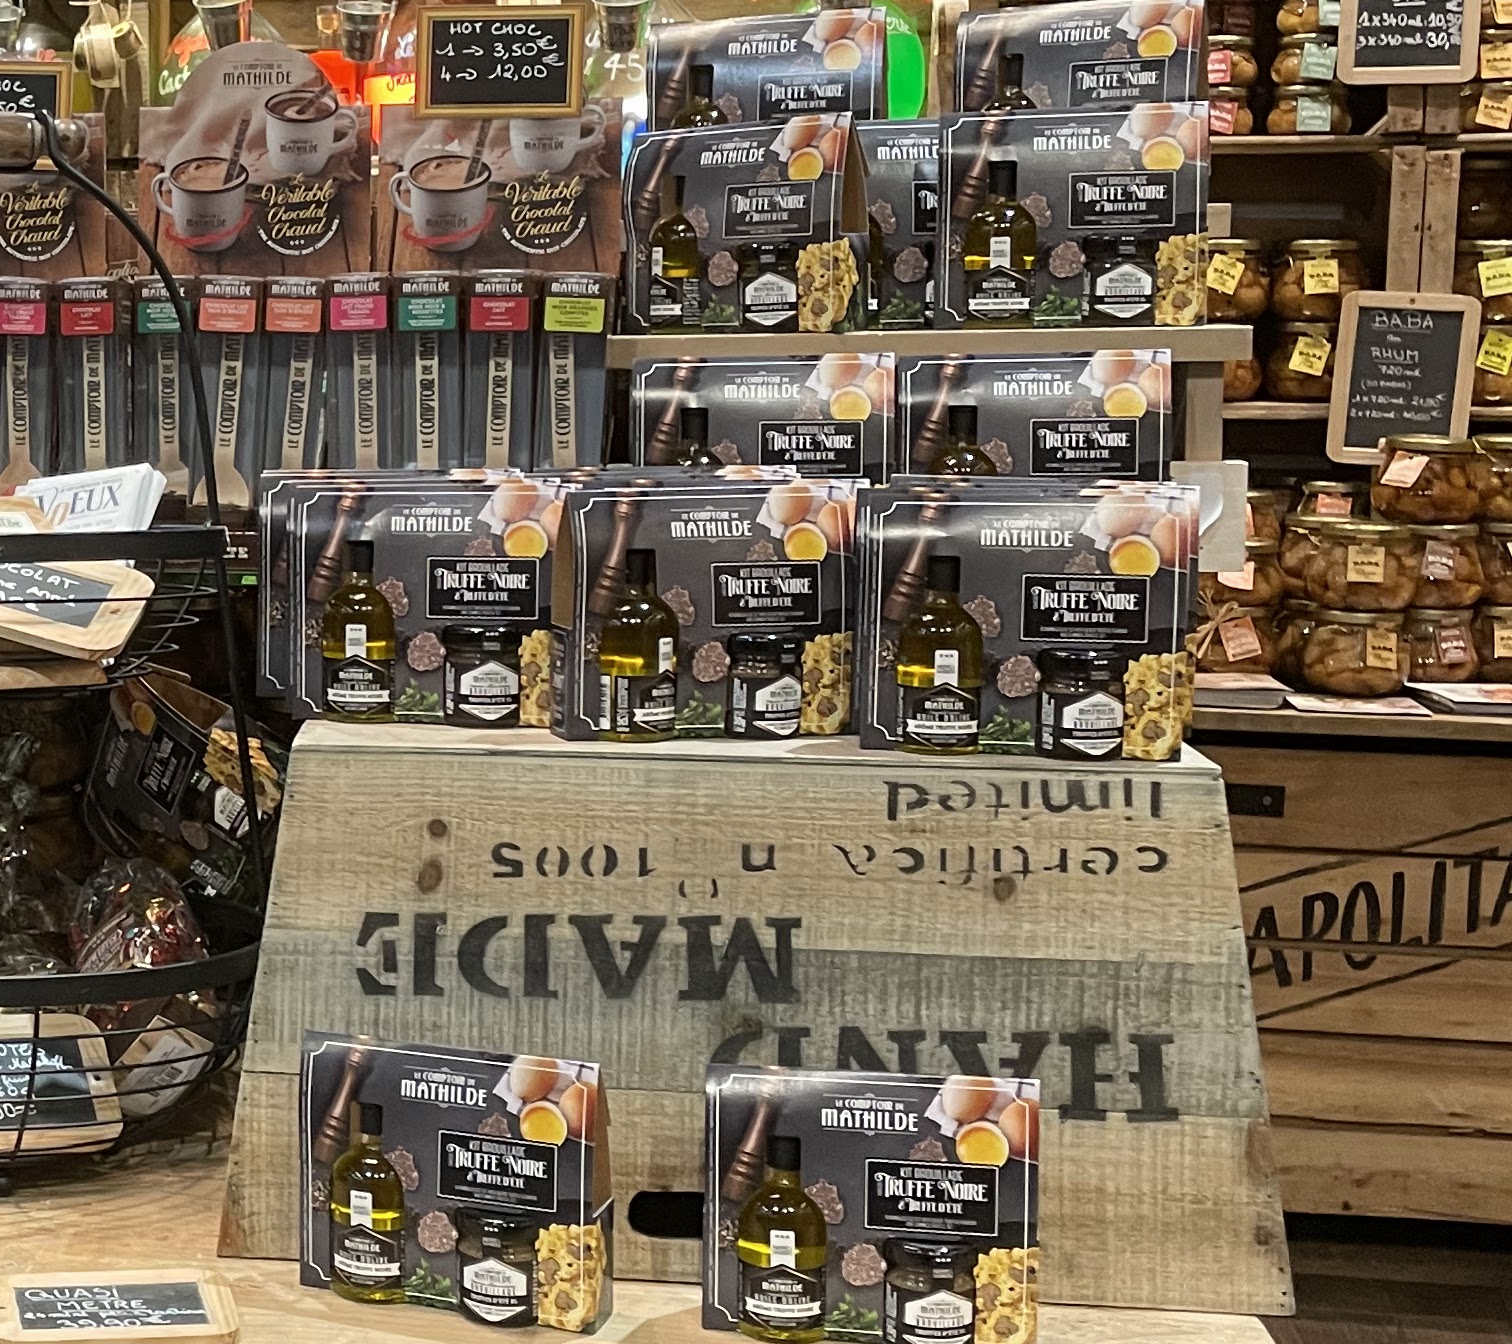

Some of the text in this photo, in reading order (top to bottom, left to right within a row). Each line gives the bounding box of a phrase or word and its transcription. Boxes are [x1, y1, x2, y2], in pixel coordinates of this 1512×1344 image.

[449, 22, 541, 36] HOT CHOC
[1039, 26, 1112, 45] MATHILDE
[222, 69, 293, 86] MATHILDE
[1032, 134, 1112, 152] MATHILDE
[271, 220, 324, 239] Chaud
[1370, 310, 1434, 329] BABA
[1371, 346, 1419, 363] RHUM
[724, 384, 801, 400] MATHILDE
[671, 519, 752, 538] MATHILDE
[981, 527, 1073, 547] MATHILDE
[355, 913, 802, 1003] MADE
[400, 1079, 488, 1107] MATHILDE
[822, 1108, 918, 1133] MATHILDE
[25, 1286, 120, 1300] QUASI
[58, 1299, 147, 1311] METRE
